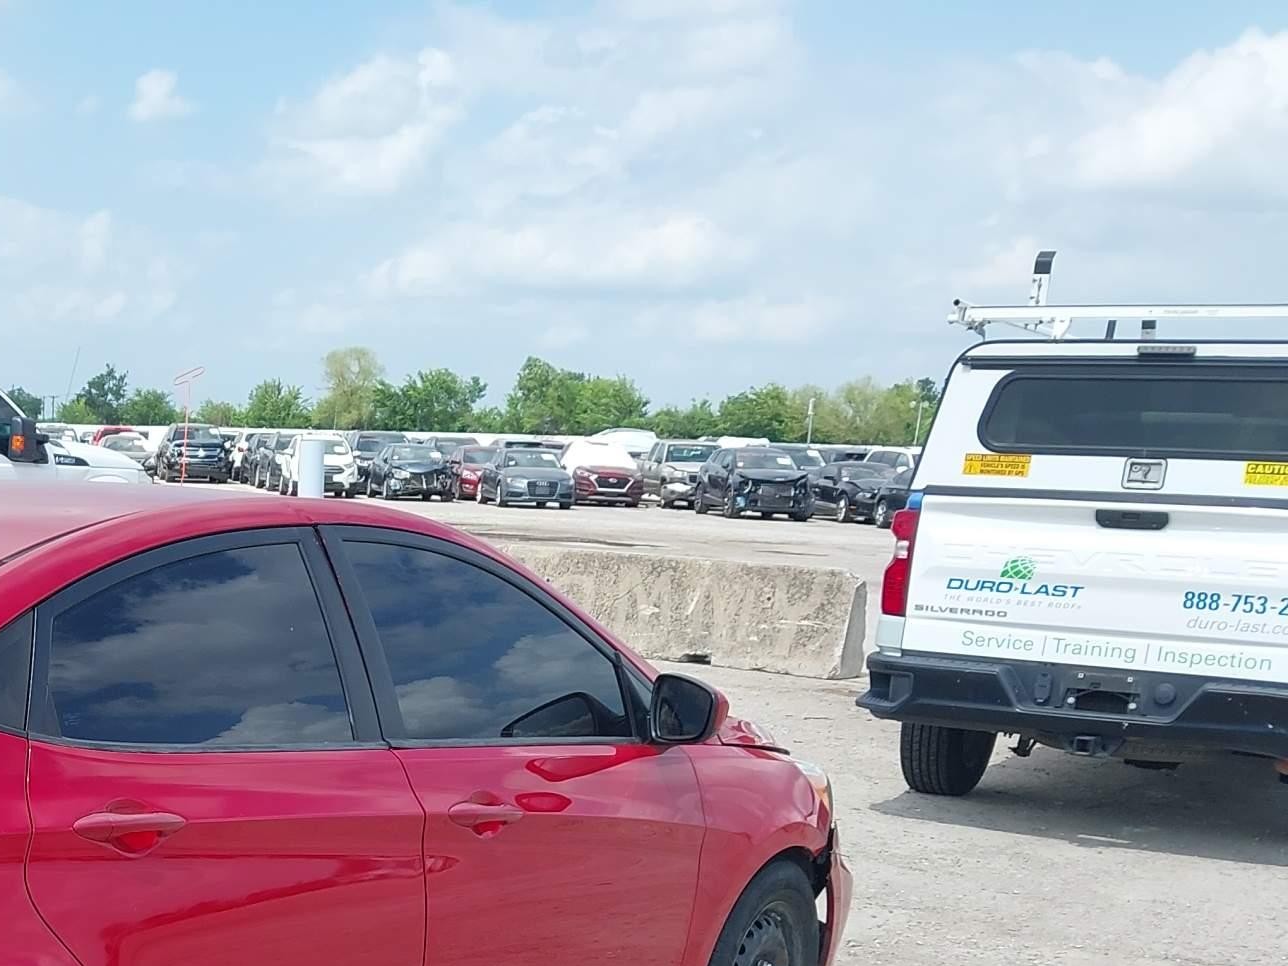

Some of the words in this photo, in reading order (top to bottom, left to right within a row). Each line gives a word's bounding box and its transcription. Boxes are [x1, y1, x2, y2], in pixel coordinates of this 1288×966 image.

[943, 593, 961, 602] THE
[914, 603, 1008, 618] SILVERADO
[961, 630, 1034, 651] Service
[1052, 636, 1137, 663] Training
[1157, 645, 1272, 671] Inspection
